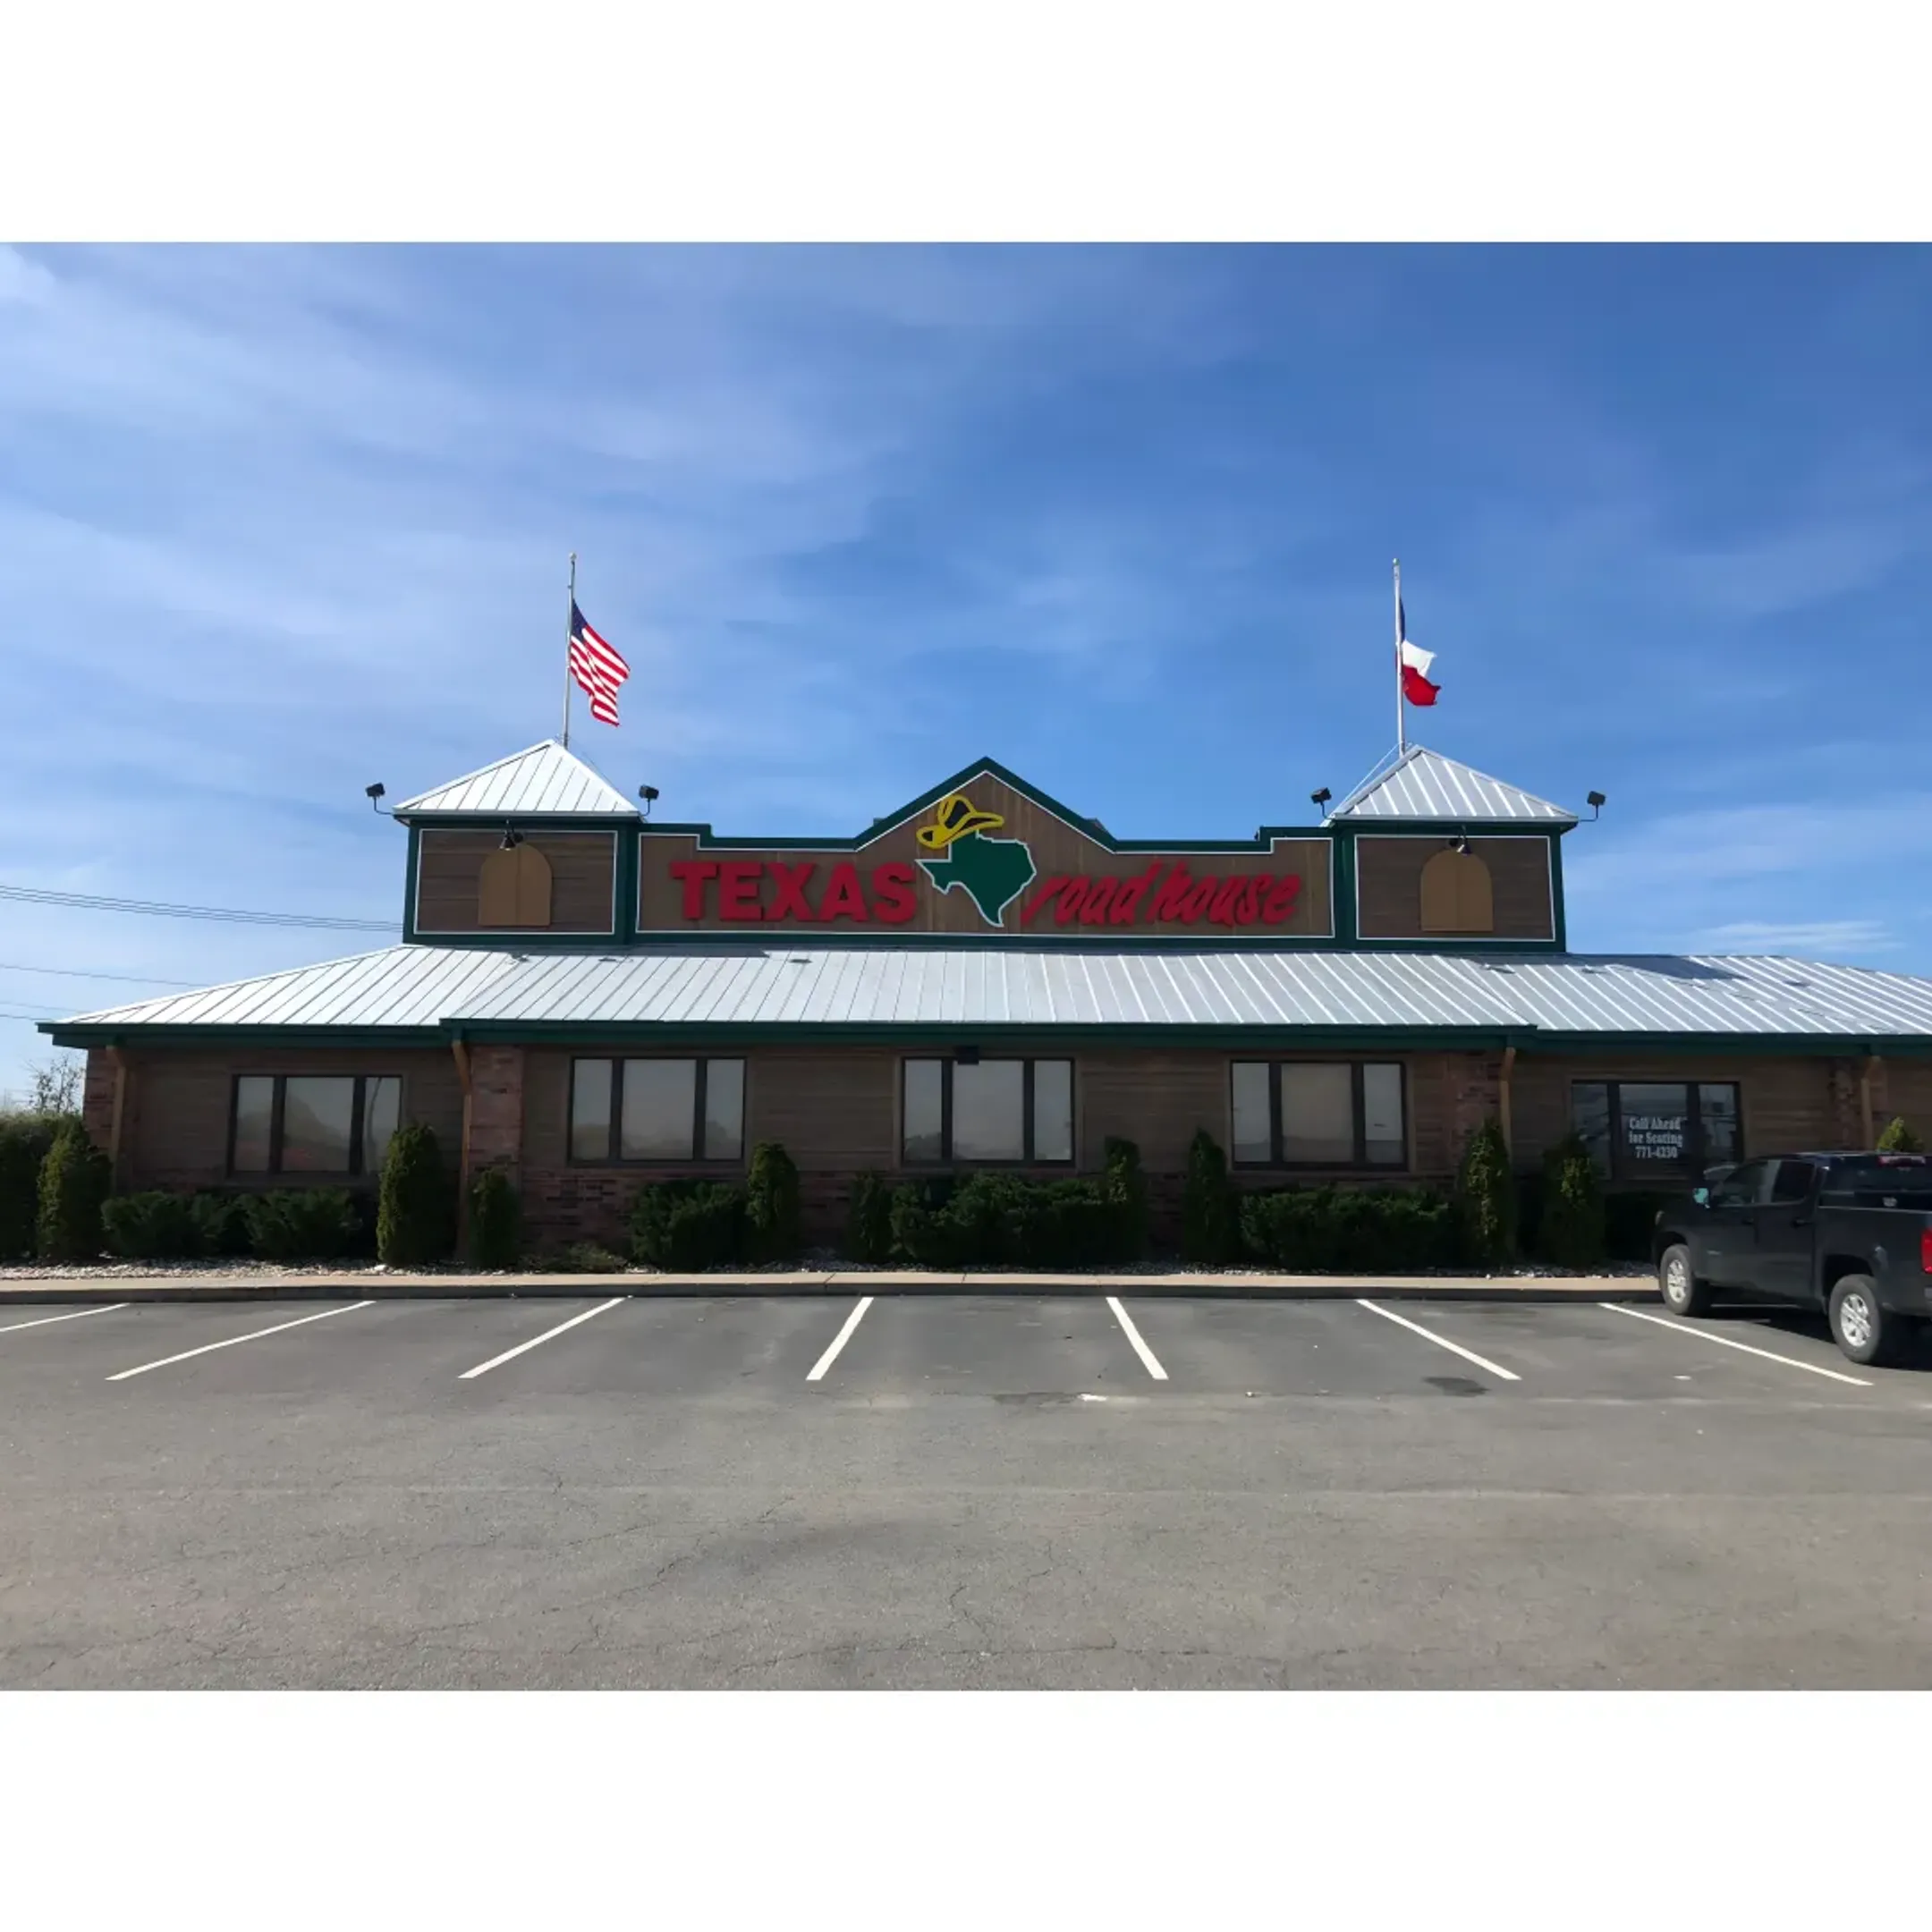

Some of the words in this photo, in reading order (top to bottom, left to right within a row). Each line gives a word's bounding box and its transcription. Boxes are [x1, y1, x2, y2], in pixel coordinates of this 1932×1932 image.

[670, 861, 917, 922] TEXAS
[1630, 1118, 1648, 1130] Call
[1651, 1117, 1681, 1130] Ahead
[1629, 1131, 1644, 1144] for
[1646, 1131, 1682, 1148] Seating
